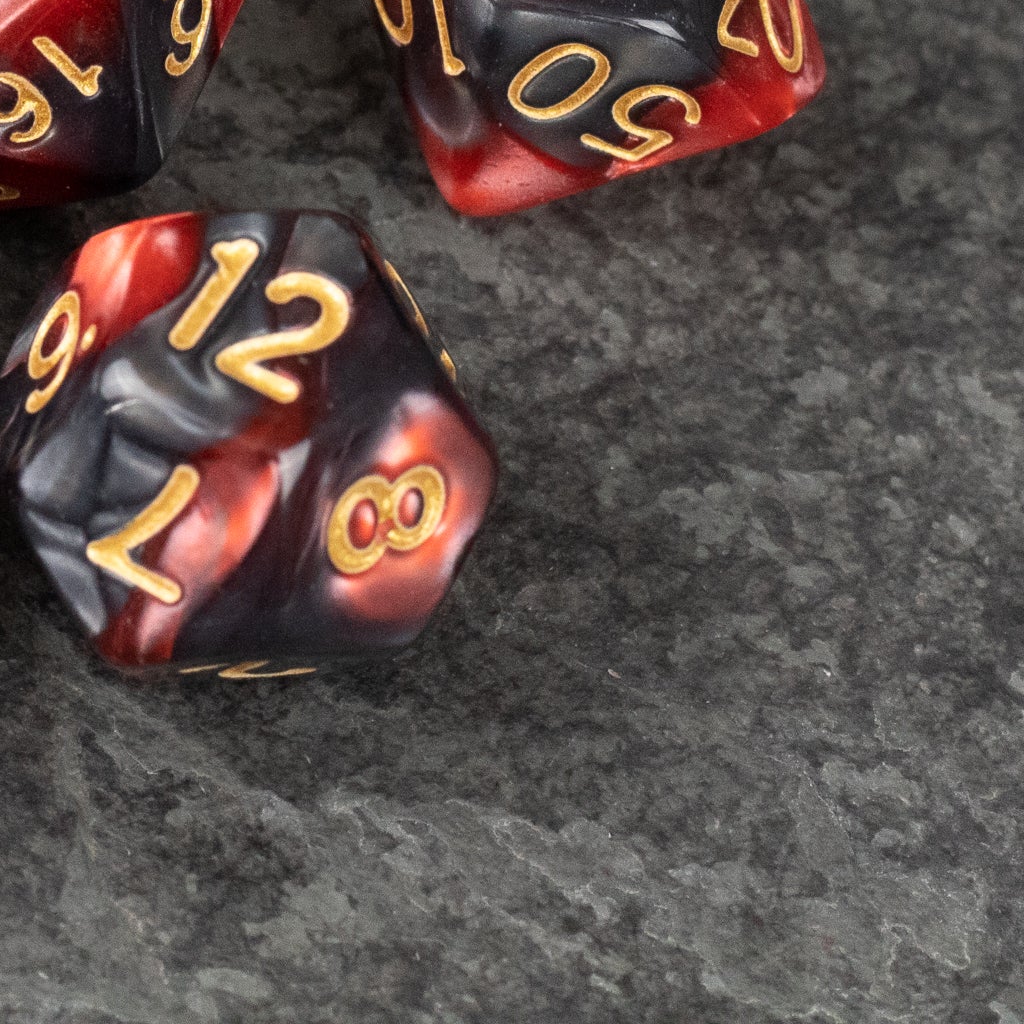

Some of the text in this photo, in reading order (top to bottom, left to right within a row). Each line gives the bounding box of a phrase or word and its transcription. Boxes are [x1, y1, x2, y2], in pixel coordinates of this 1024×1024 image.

[507, 43, 701, 161] 50
[168, 238, 349, 403] 12
[88, 465, 199, 603] 7
[327, 465, 445, 573] 8
